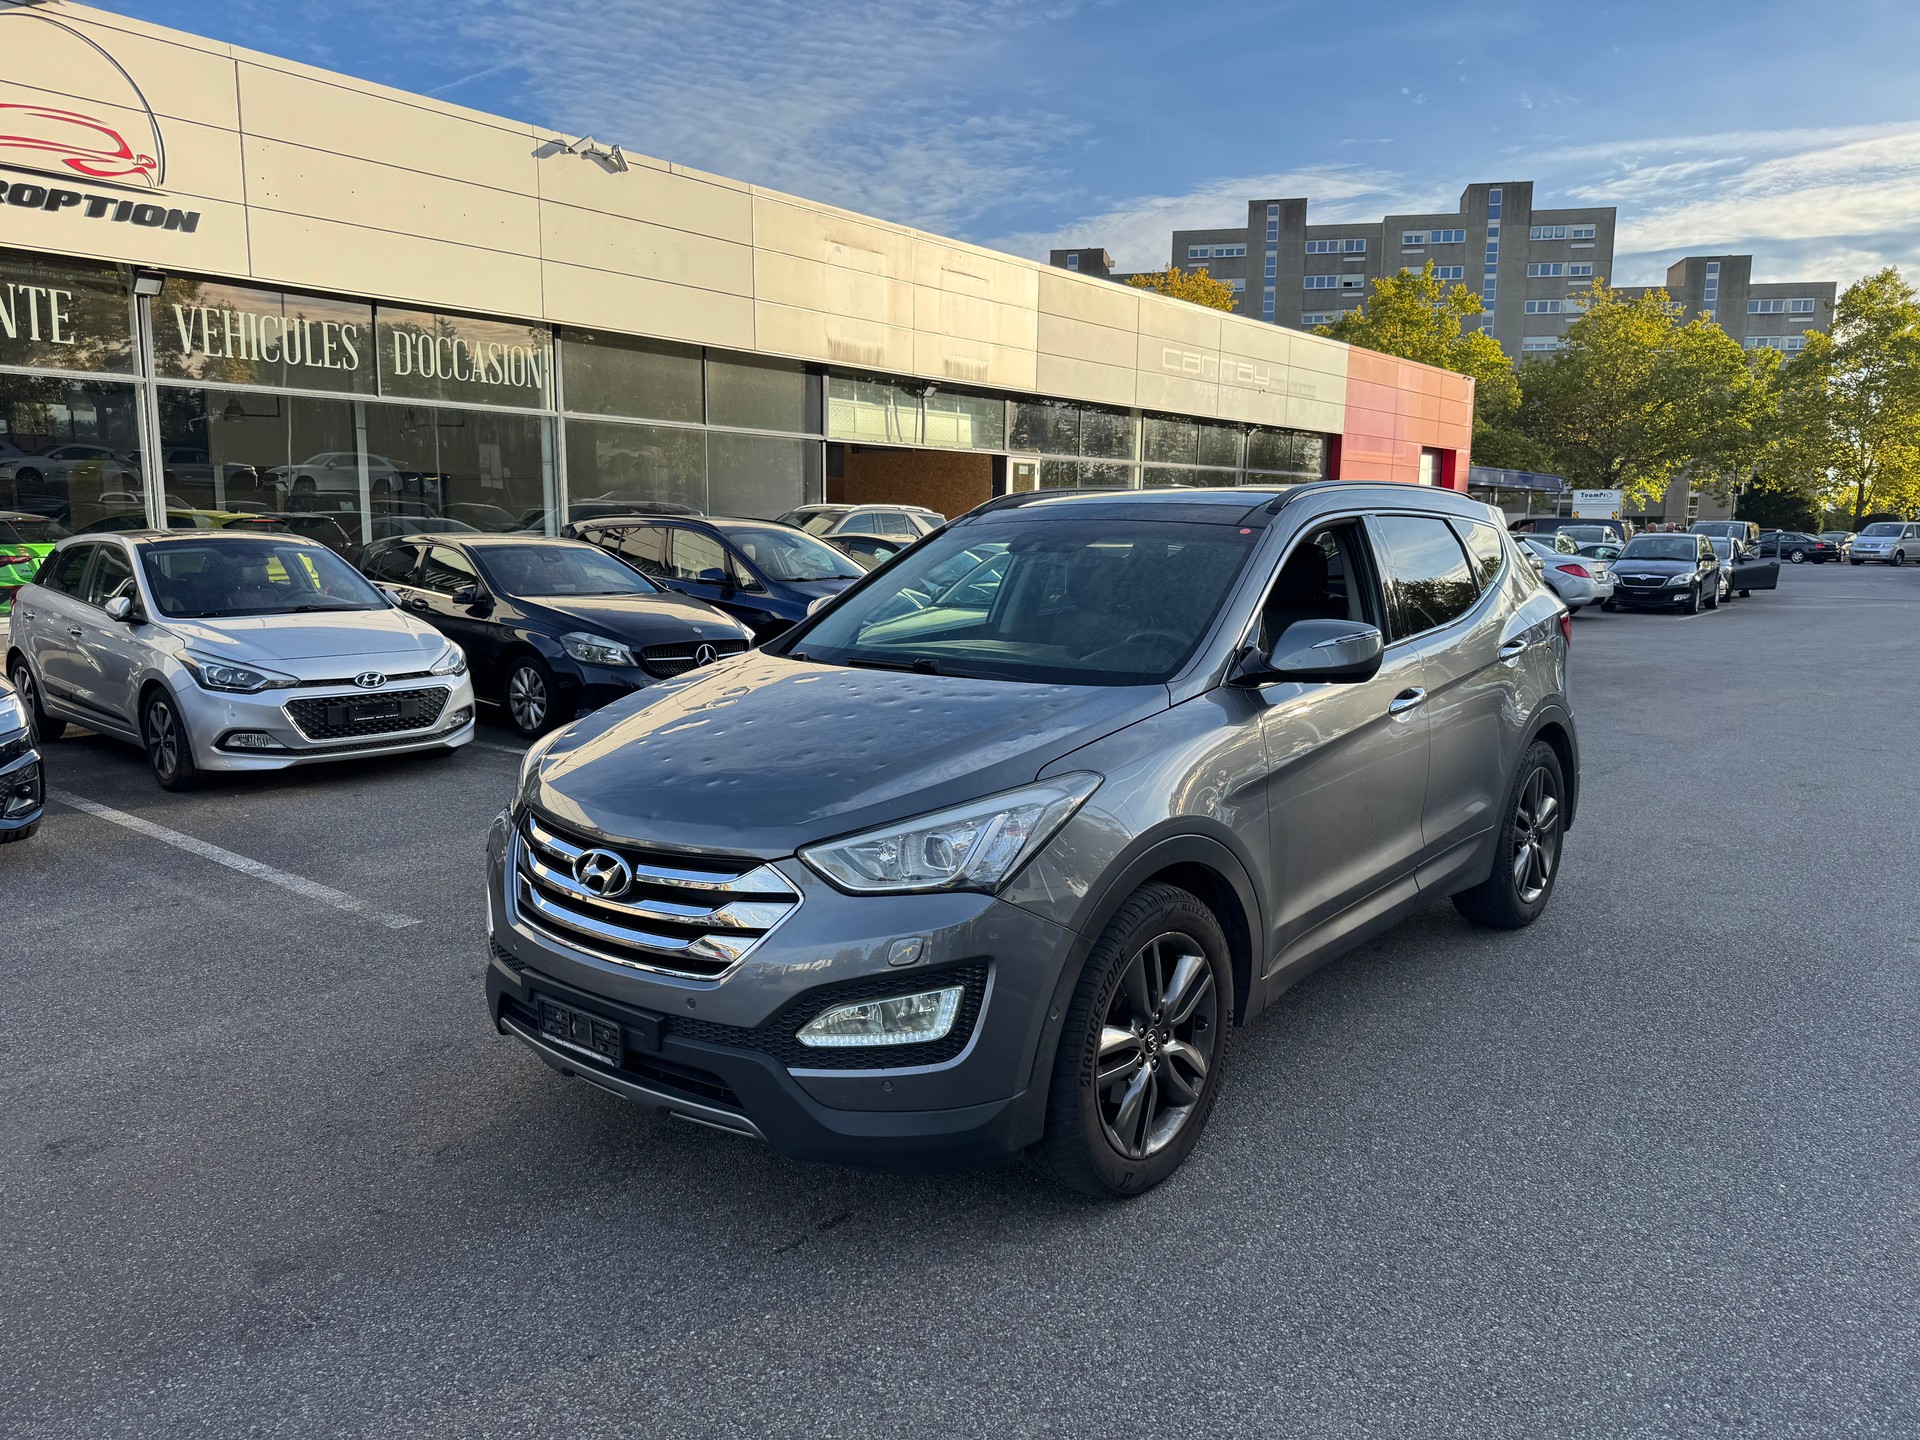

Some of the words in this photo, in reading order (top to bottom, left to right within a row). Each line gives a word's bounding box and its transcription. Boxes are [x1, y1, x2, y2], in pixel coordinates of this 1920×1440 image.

[0, 180, 201, 233] OPTION
[172, 304, 359, 371] VEHICULES
[393, 331, 543, 389] D'OCCASION
[1163, 347, 1270, 386] carray
[1080, 946, 1127, 1088] BRIDGESTONE
